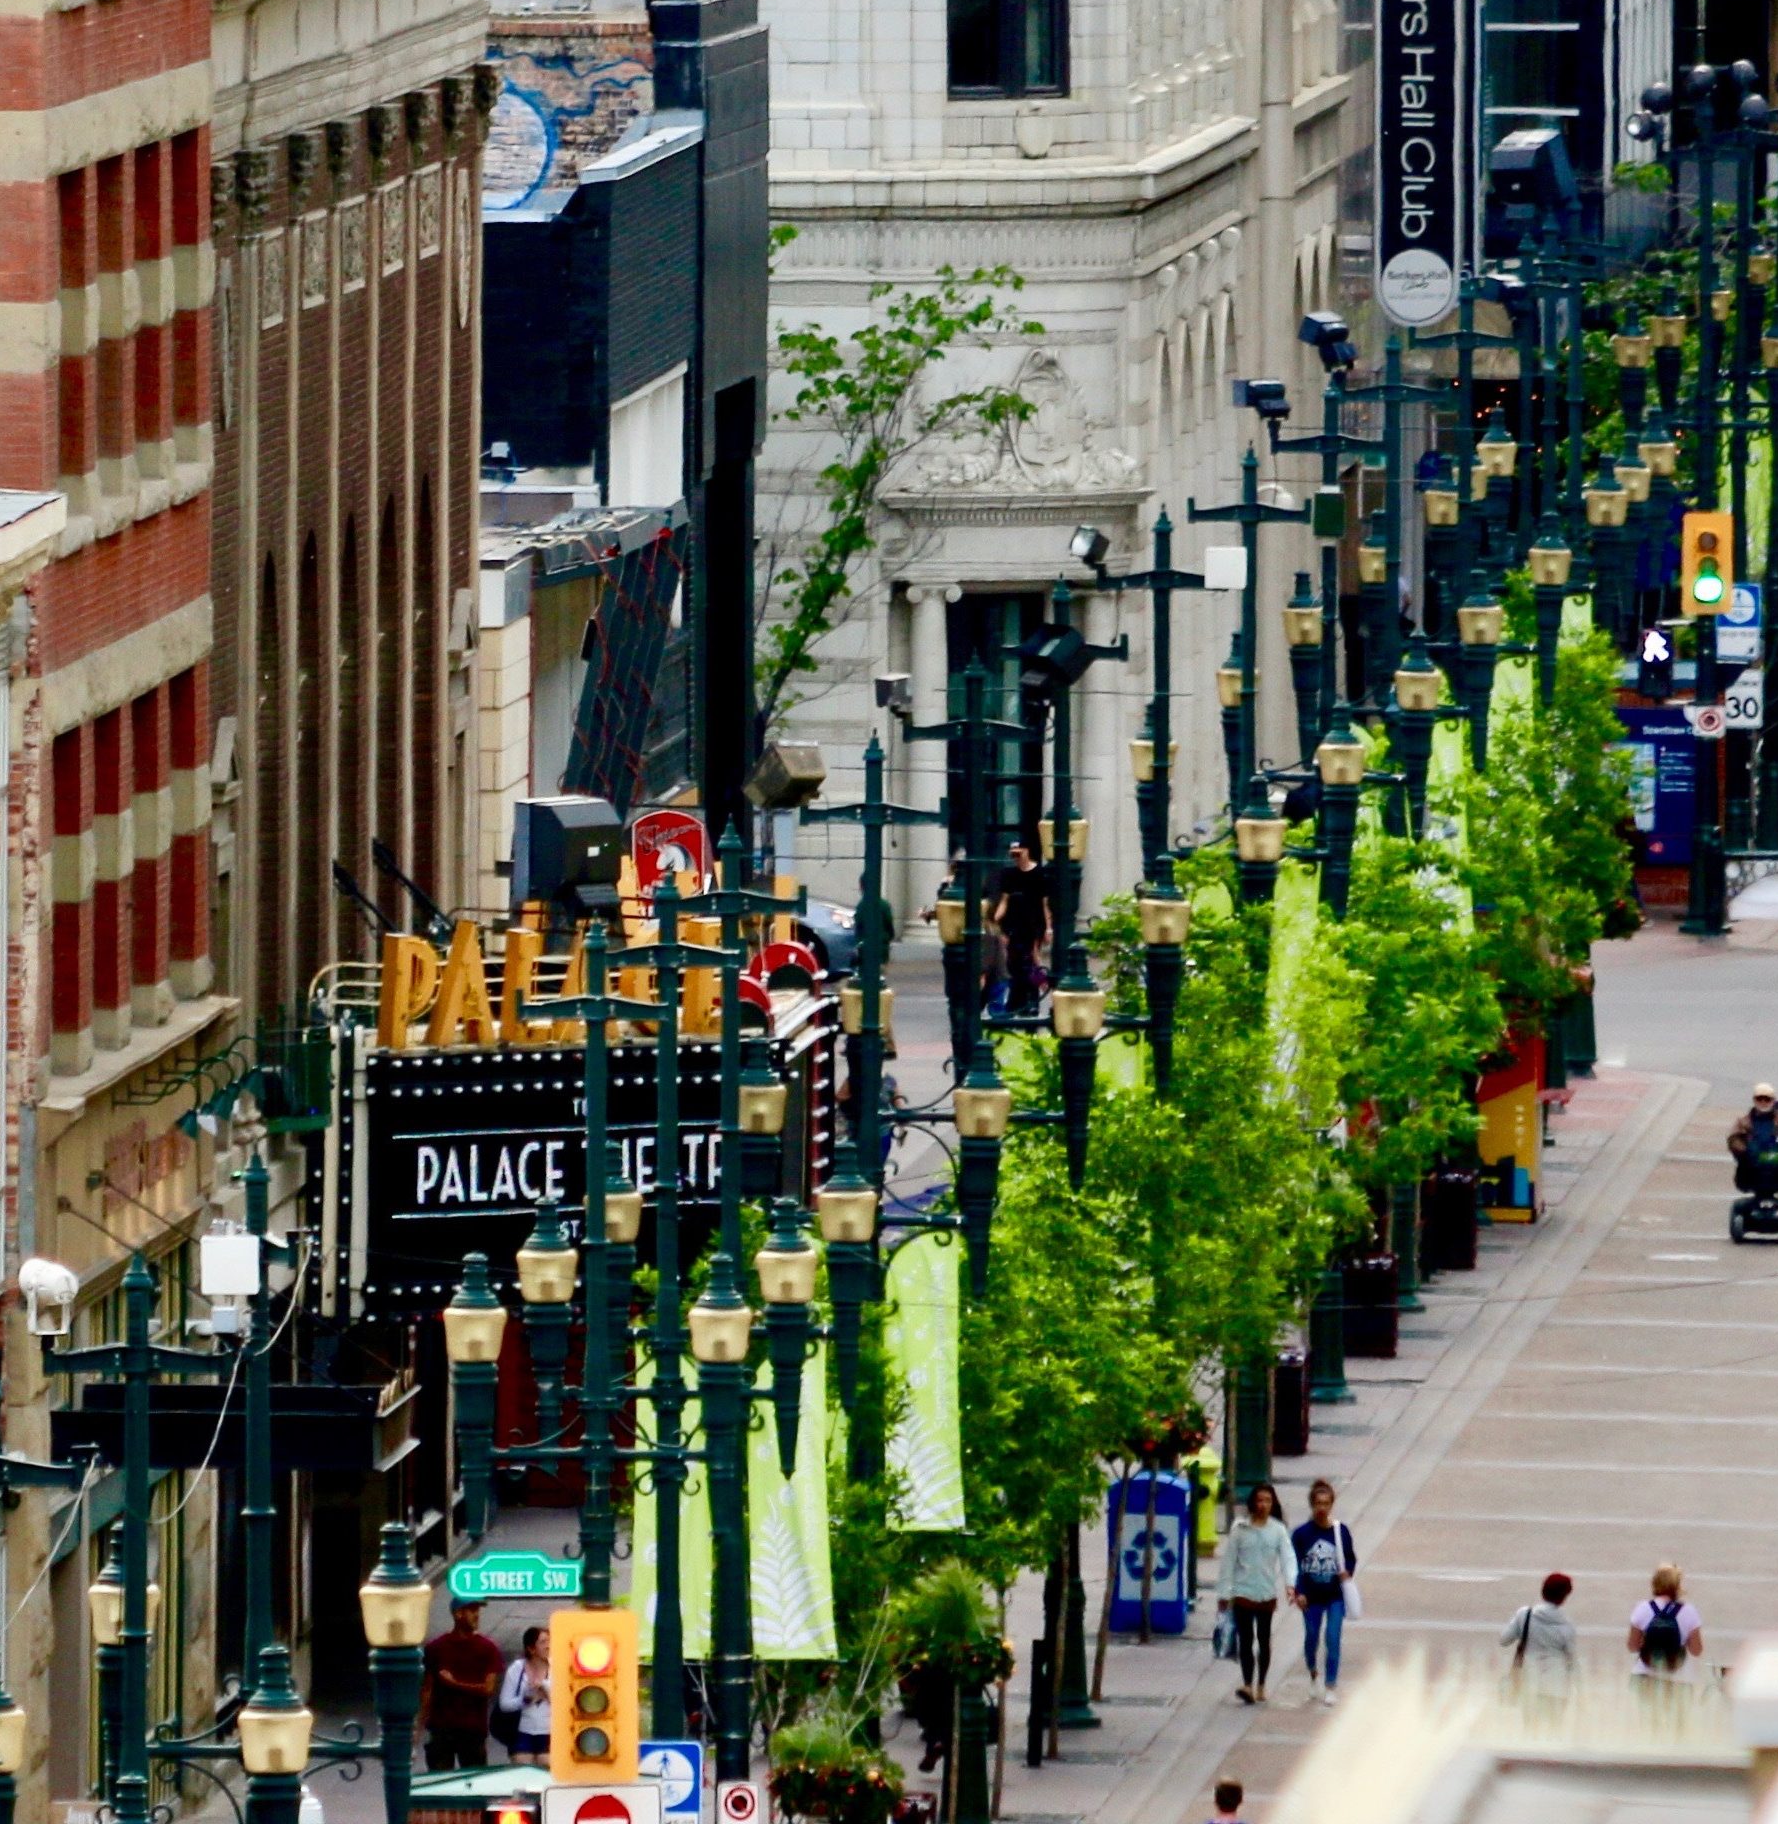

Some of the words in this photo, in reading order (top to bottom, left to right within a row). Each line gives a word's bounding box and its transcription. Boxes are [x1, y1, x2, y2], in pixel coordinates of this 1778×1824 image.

[1401, 46, 1435, 128] Hall
[1400, 137, 1436, 240] Club
[1726, 696, 1759, 719] 30
[416, 1141, 565, 1204] PALACE
[463, 1572, 471, 1590] 1
[479, 1570, 534, 1591] STREET
[542, 1570, 569, 1590] SW
